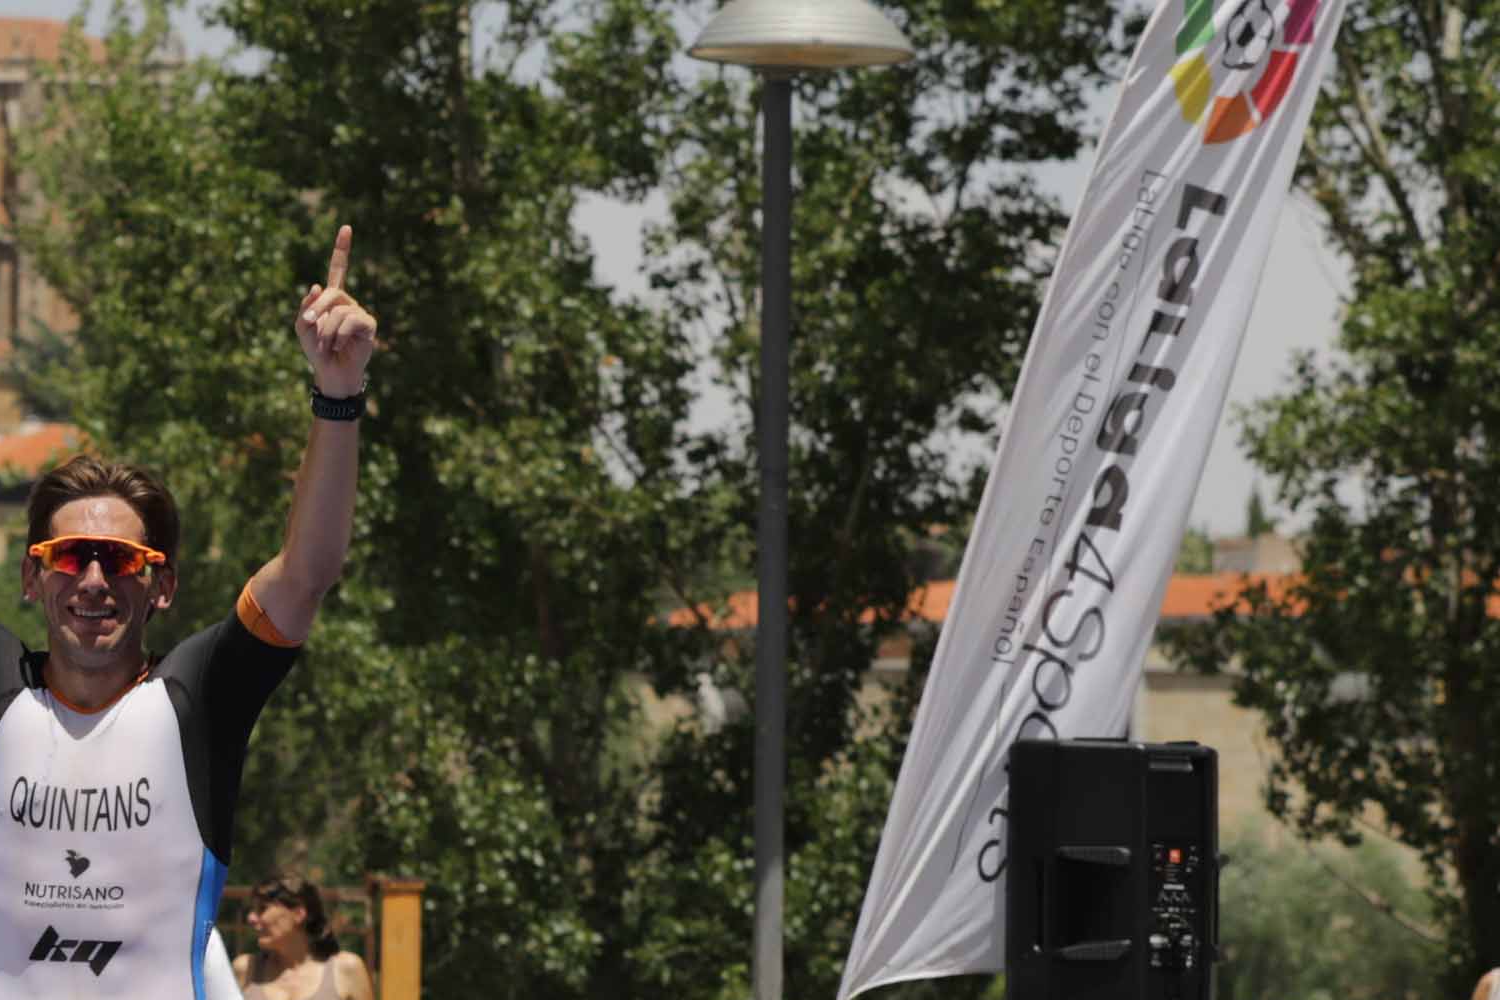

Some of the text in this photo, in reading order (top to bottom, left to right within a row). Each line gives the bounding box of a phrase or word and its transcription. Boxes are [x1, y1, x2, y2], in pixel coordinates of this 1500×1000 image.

[1092, 280, 1120, 341] con
[1083, 352, 1101, 383] el
[1039, 390, 1097, 527] Deporte
[991, 536, 1046, 665] Español
[9, 776, 151, 833] QUINTANS
[24, 881, 125, 902] NUTRISANO
